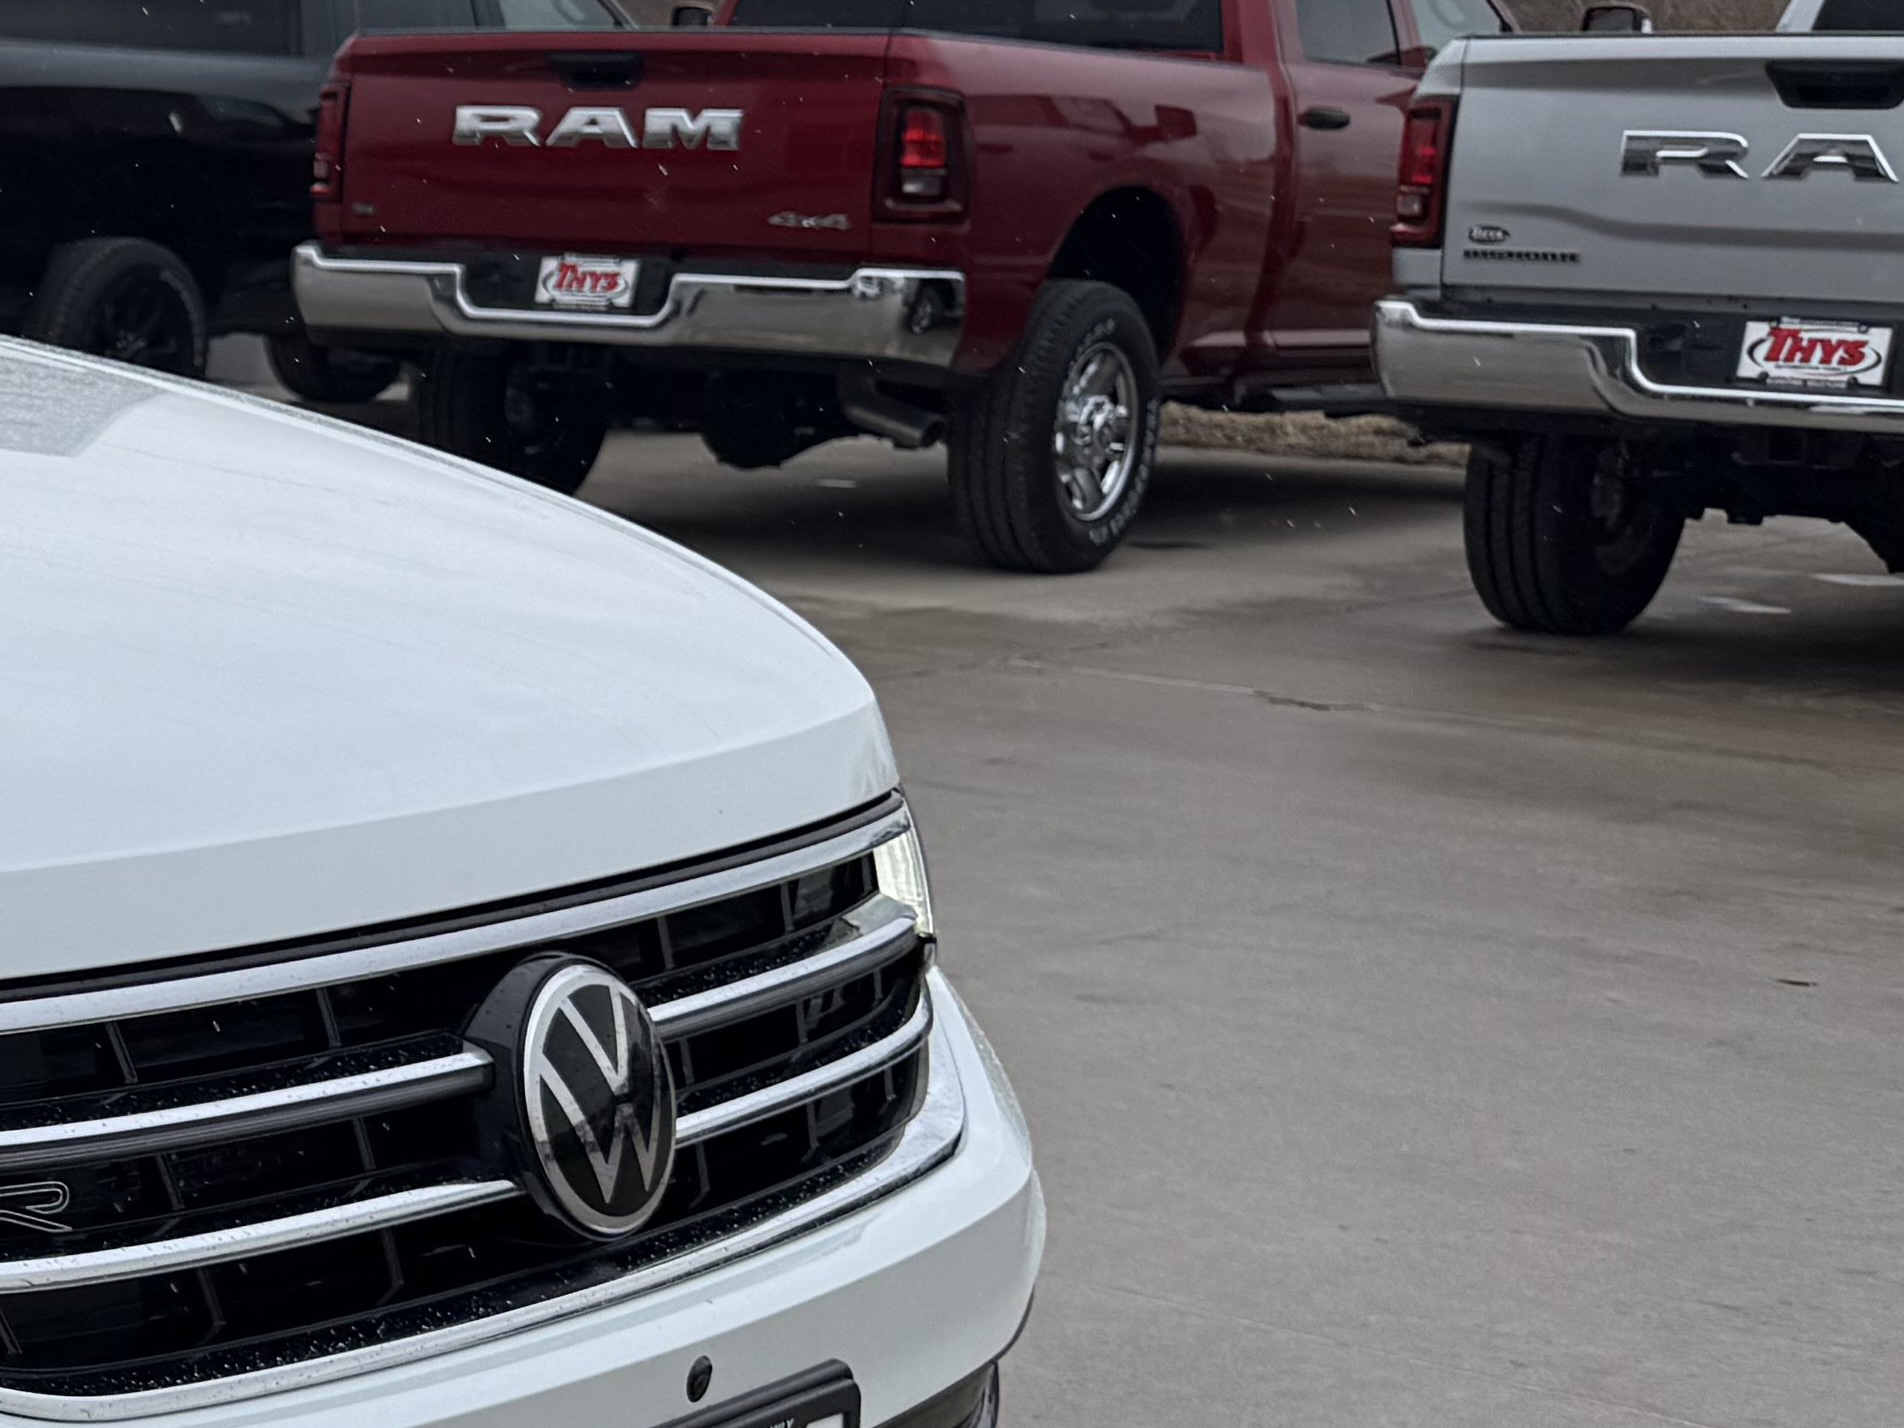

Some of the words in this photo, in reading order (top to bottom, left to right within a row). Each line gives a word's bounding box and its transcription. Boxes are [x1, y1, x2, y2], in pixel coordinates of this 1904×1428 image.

[452, 105, 744, 151] RAM
[555, 263, 620, 292] THYS
[1764, 327, 1869, 367] THYS
